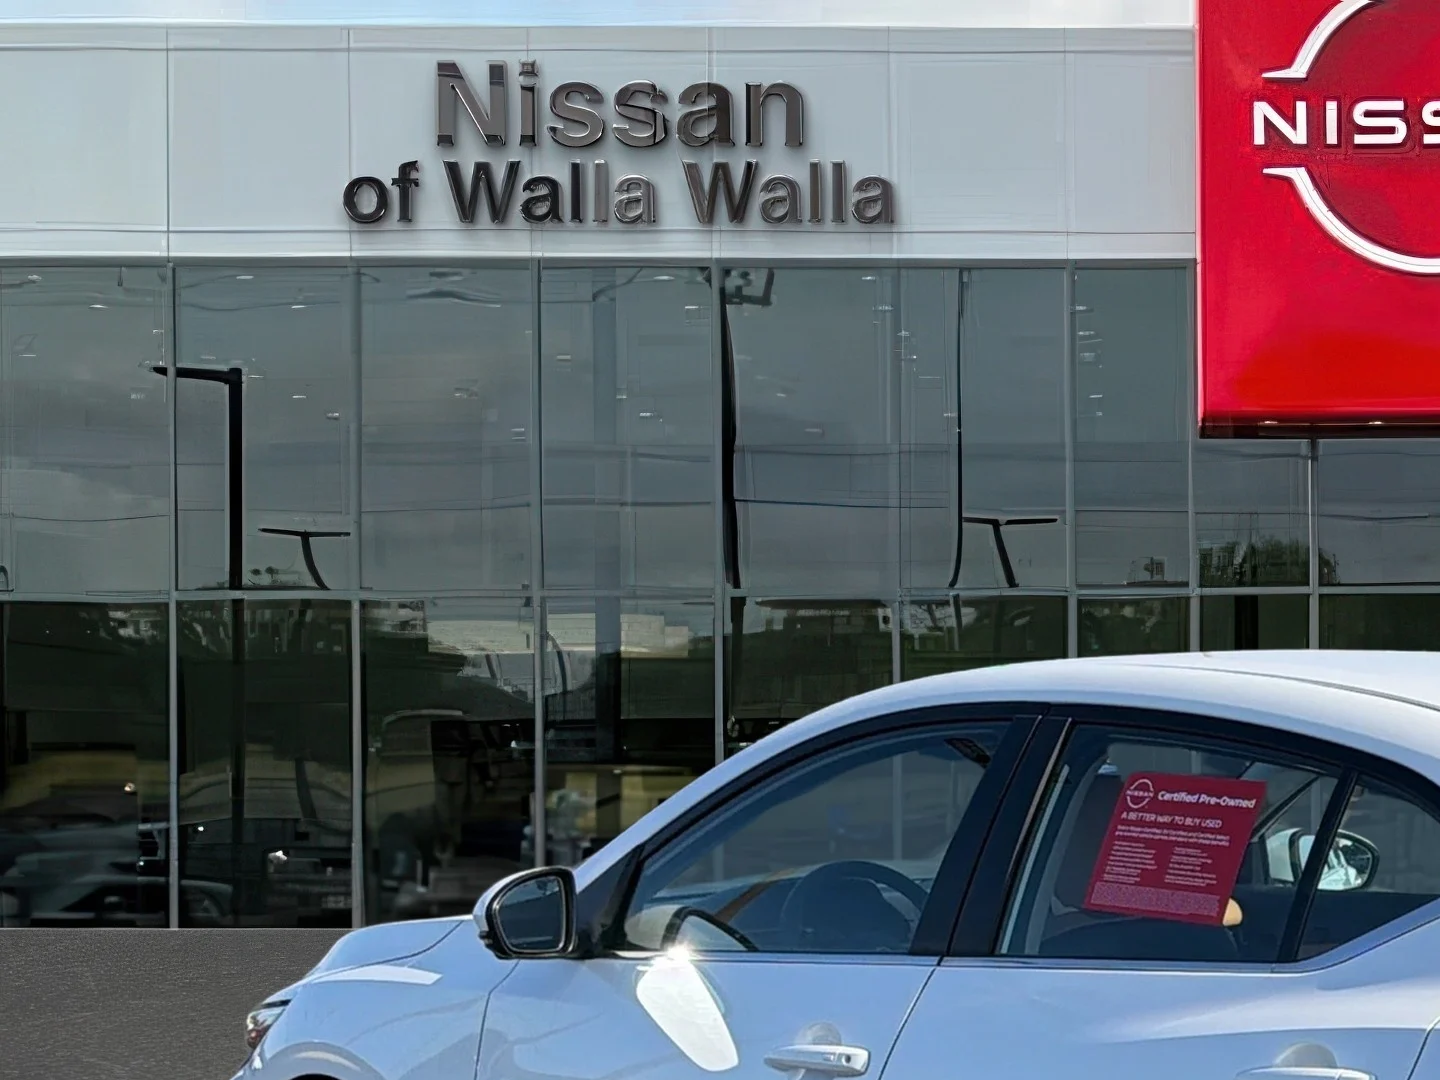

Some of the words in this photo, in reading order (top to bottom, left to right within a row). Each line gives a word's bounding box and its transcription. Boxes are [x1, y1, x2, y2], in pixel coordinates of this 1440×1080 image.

[434, 58, 805, 148] Nissan
[342, 159, 420, 224] of
[442, 159, 657, 225] Walla
[681, 159, 895, 225] Walla
[1127, 811, 1156, 821] BETTER
[1156, 814, 1174, 823] WAY
[1173, 815, 1184, 825] TO
[1184, 817, 1201, 826] BUY
[1200, 818, 1223, 829] USED
[1158, 791, 1199, 803] Certified
[1199, 793, 1256, 809] Pre-Owned
